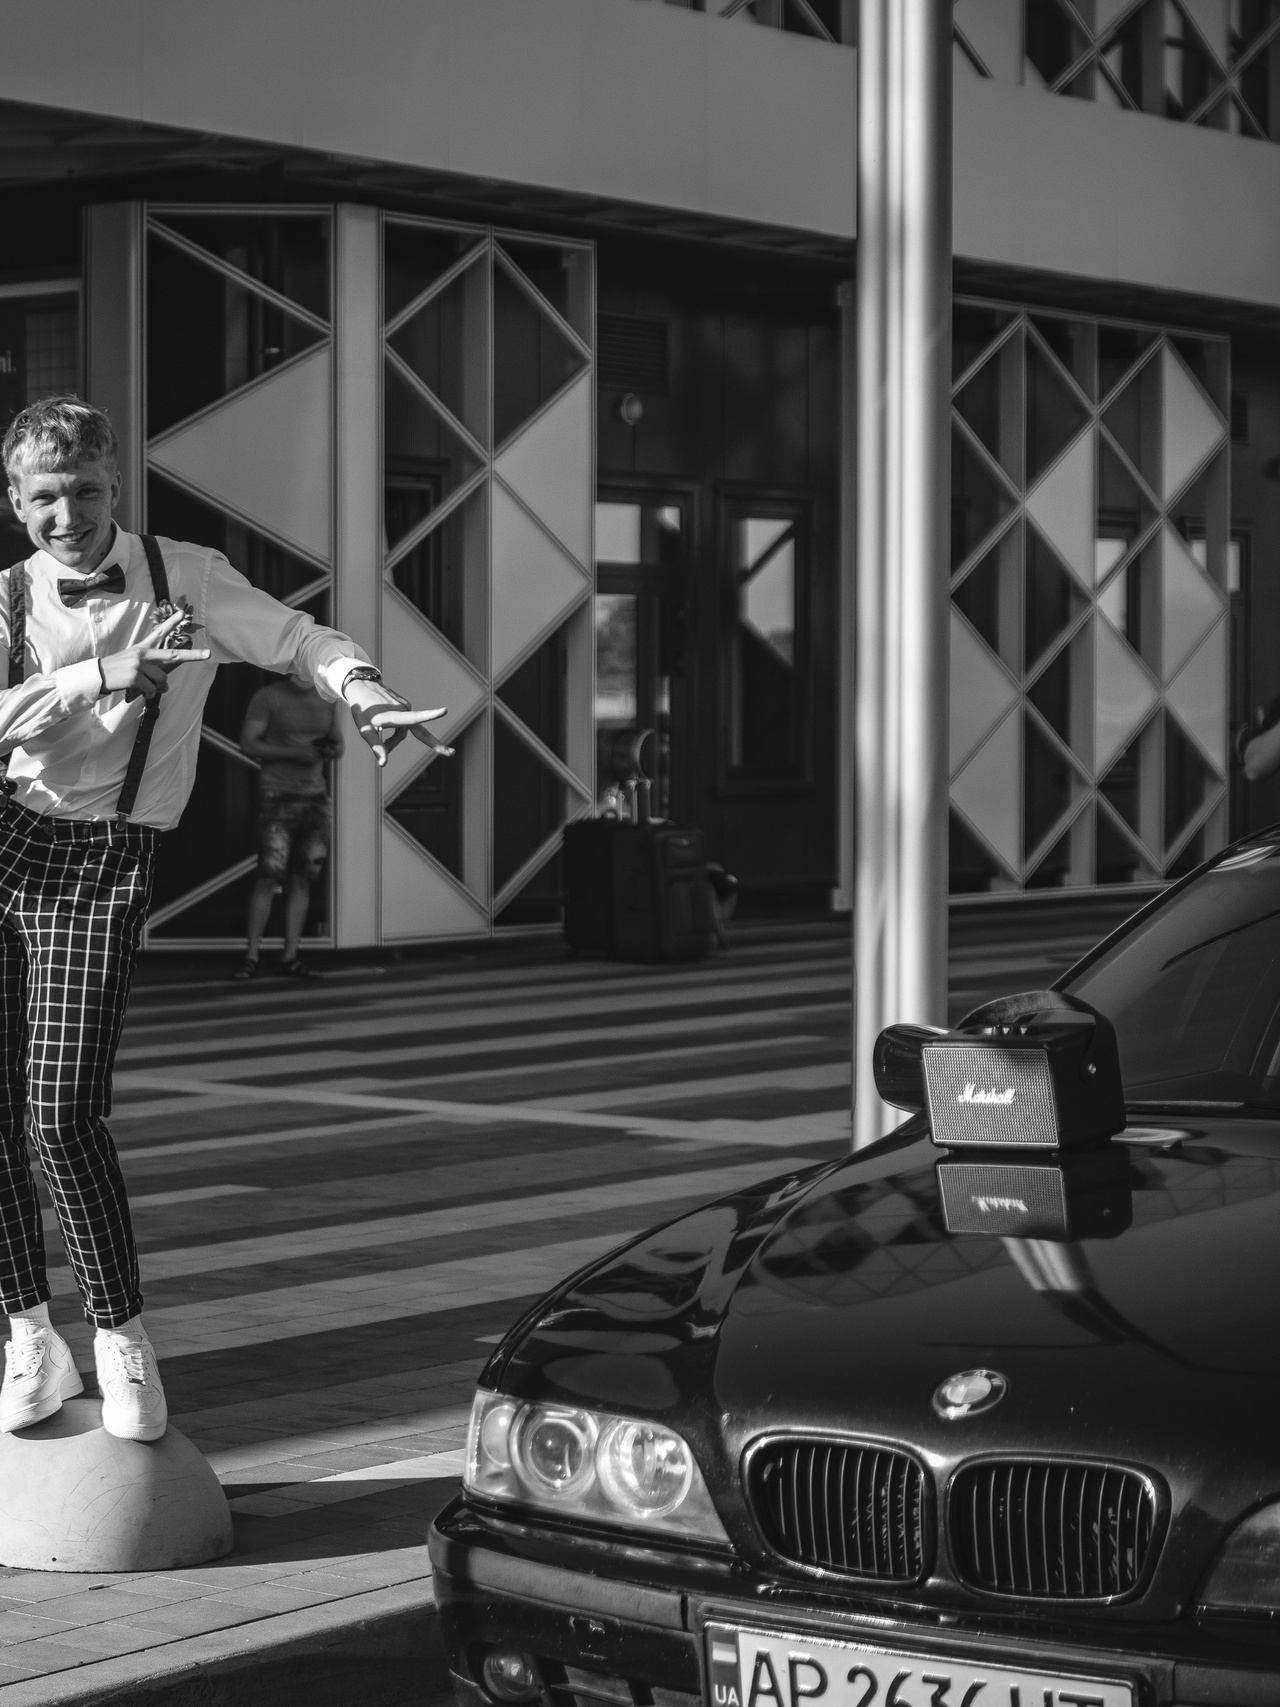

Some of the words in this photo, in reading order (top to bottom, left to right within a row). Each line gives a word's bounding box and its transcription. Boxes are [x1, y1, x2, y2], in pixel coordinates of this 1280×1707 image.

[958, 1083, 1015, 1104] Marshall
[748, 1649, 828, 1707] AP
[715, 1684, 740, 1706] UA
